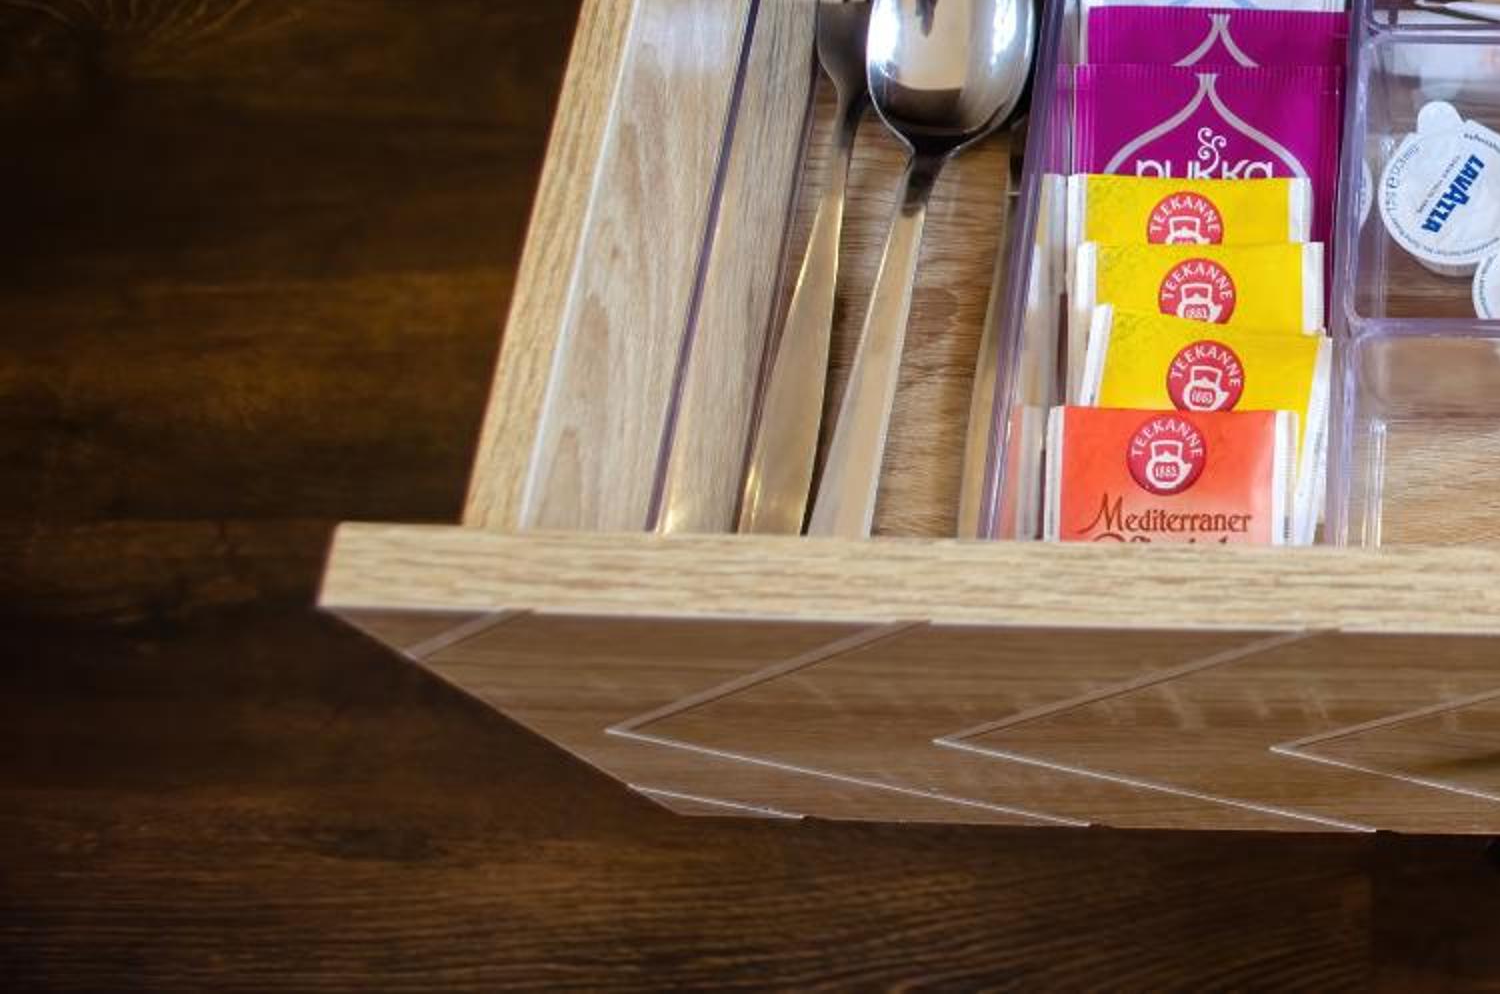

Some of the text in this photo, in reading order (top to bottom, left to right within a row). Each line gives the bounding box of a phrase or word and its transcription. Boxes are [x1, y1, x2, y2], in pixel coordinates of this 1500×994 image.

[1421, 153, 1486, 233] LAVAZZA
[1149, 195, 1221, 234] TEEKANNE
[1160, 261, 1233, 302] TEEKANNE
[1170, 345, 1241, 388] TEEKANNE
[1130, 418, 1204, 459] TEEKANNE
[1077, 493, 1253, 535] Mediterraner
